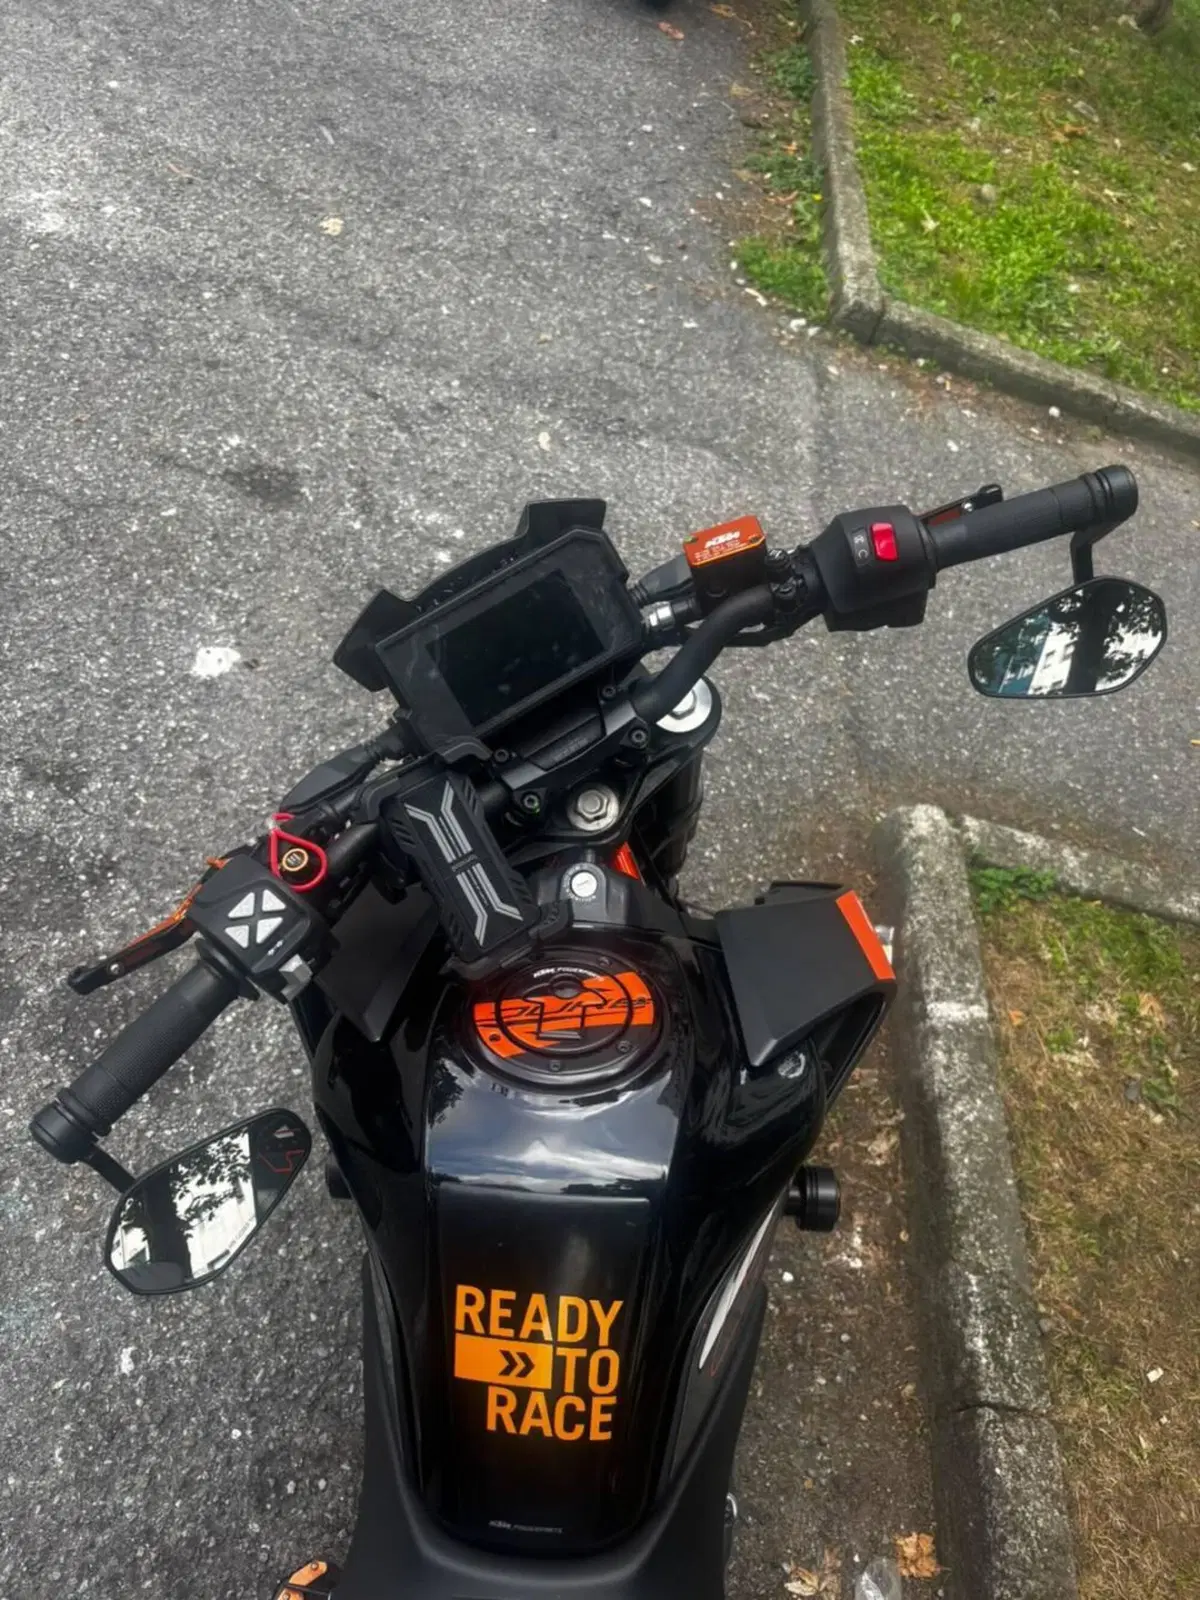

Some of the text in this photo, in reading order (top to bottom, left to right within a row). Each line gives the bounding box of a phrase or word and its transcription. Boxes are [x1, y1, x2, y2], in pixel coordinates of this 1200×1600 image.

[454, 1284, 624, 1347] READY
[556, 1346, 620, 1395] TO
[486, 1385, 618, 1442] RACE
